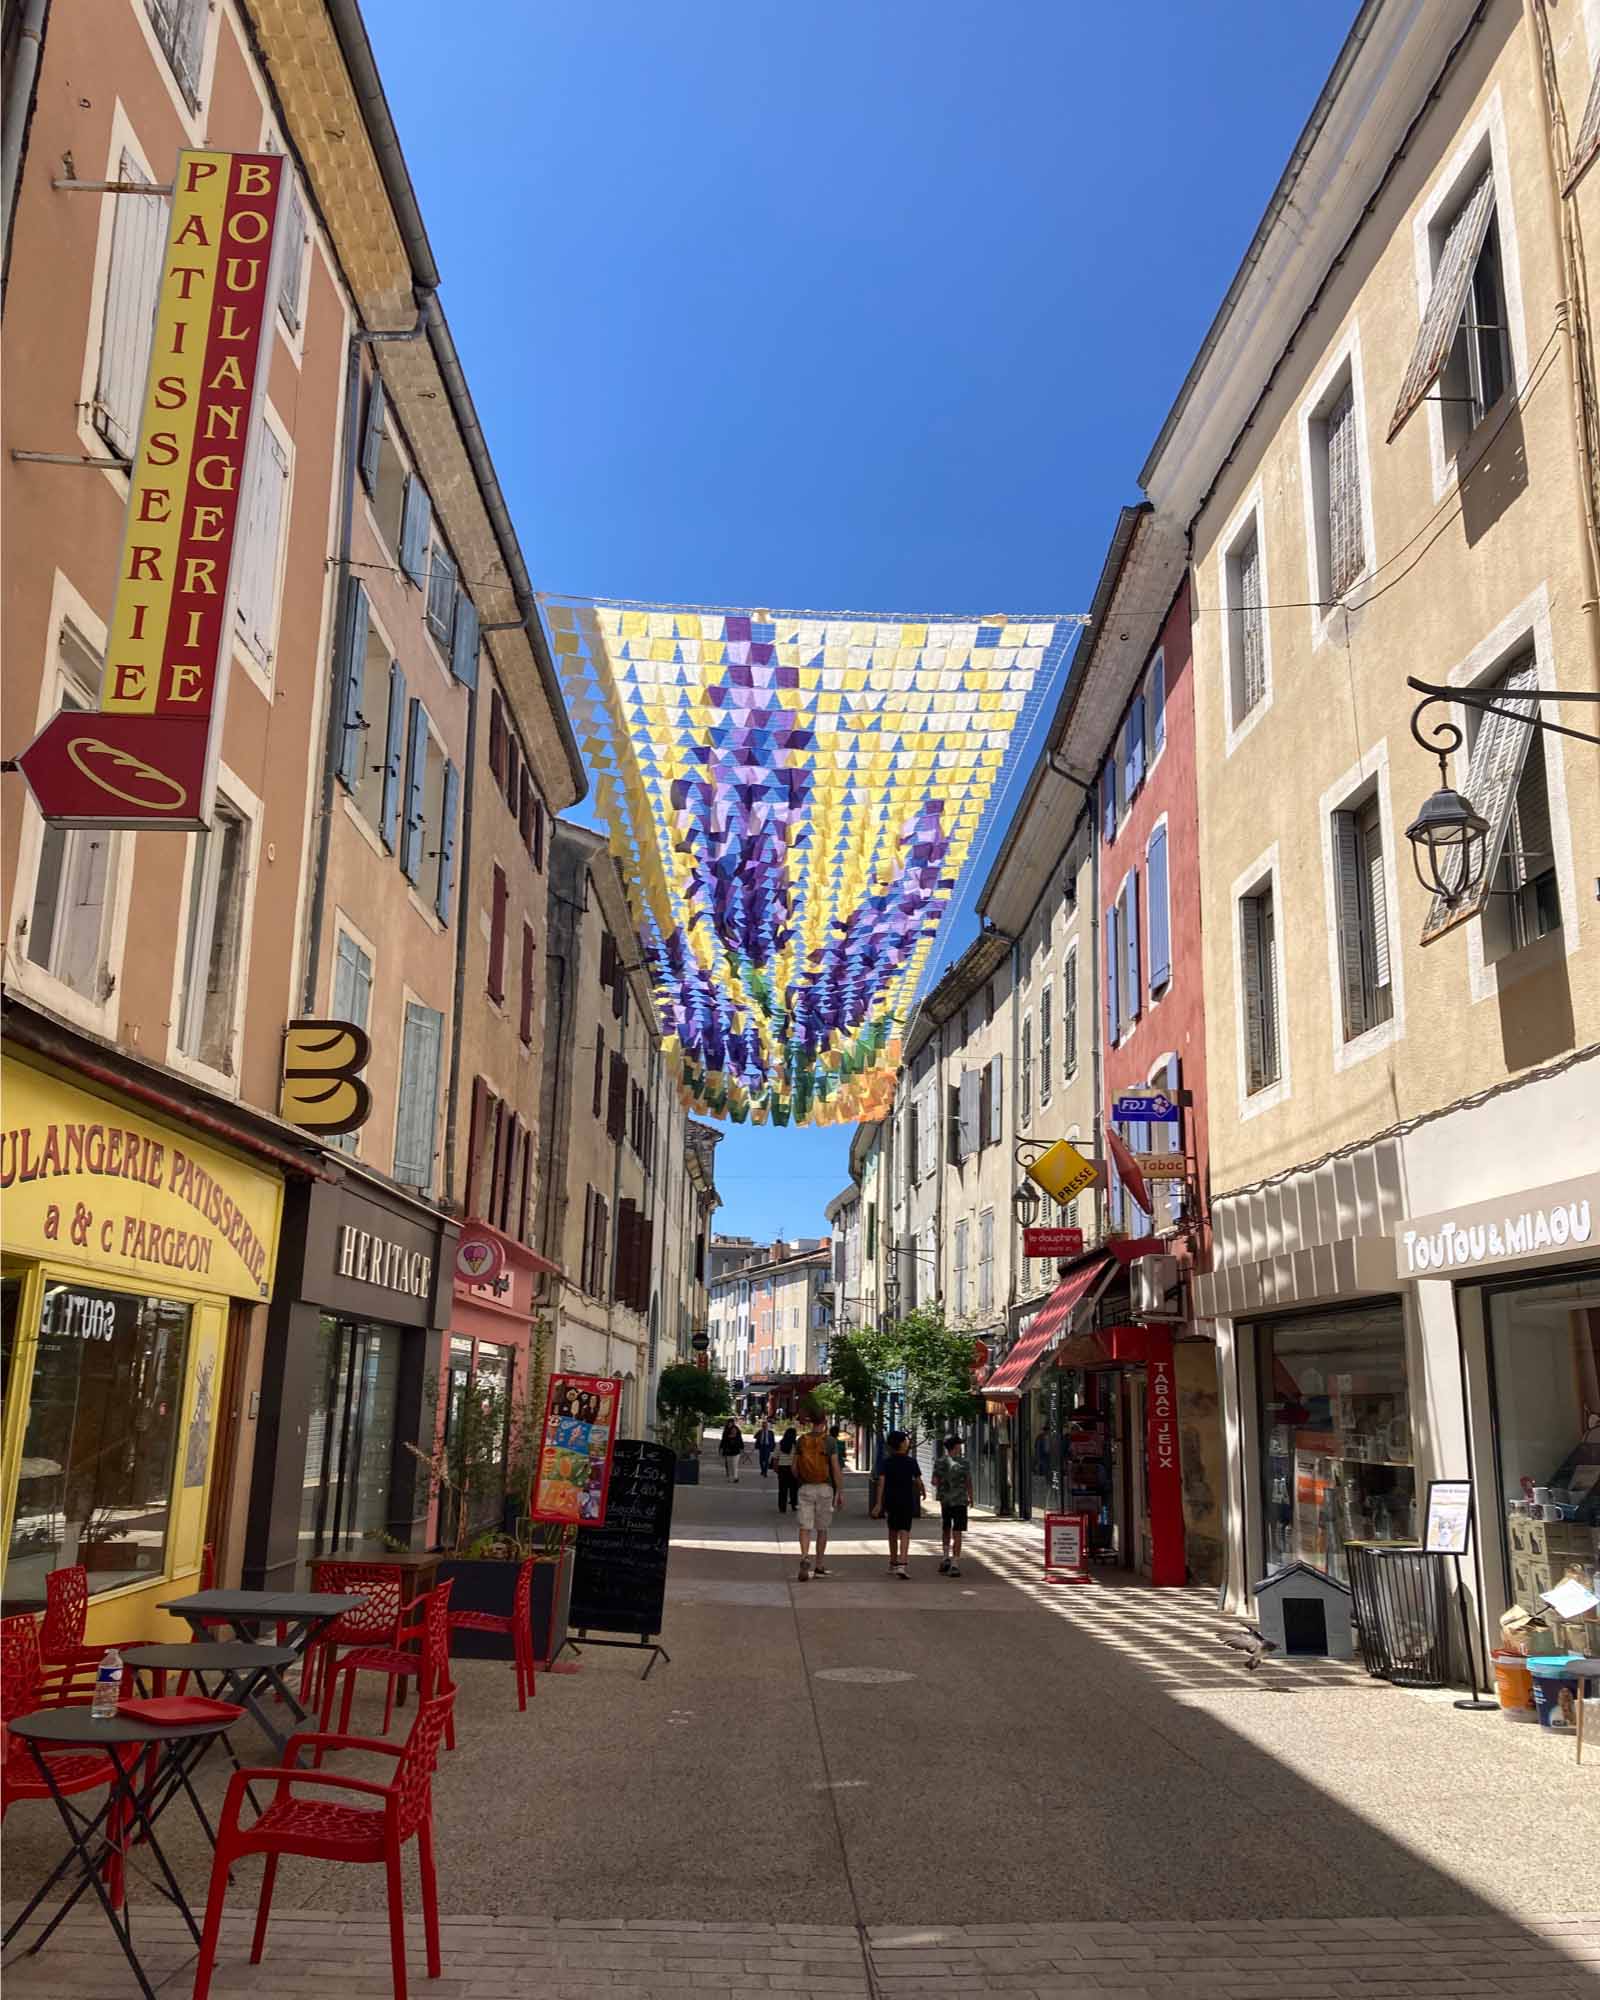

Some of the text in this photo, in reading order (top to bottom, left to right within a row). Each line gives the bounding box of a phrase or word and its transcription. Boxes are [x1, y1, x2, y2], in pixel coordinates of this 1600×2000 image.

[111, 161, 219, 702] PATISSERIE
[167, 162, 273, 704] BOULANGERIE
[1121, 1101, 1147, 1110] FDJ
[1057, 1167, 1094, 1200] PRESSE
[1142, 1159, 1183, 1171] Tabac
[70, 1201, 93, 1247] &
[120, 1215, 213, 1274] FARGEON
[168, 1149, 266, 1286] PATISSERIE
[339, 1224, 432, 1299] HERITAGE
[1153, 1362, 1173, 1468] TABAC JEUX
